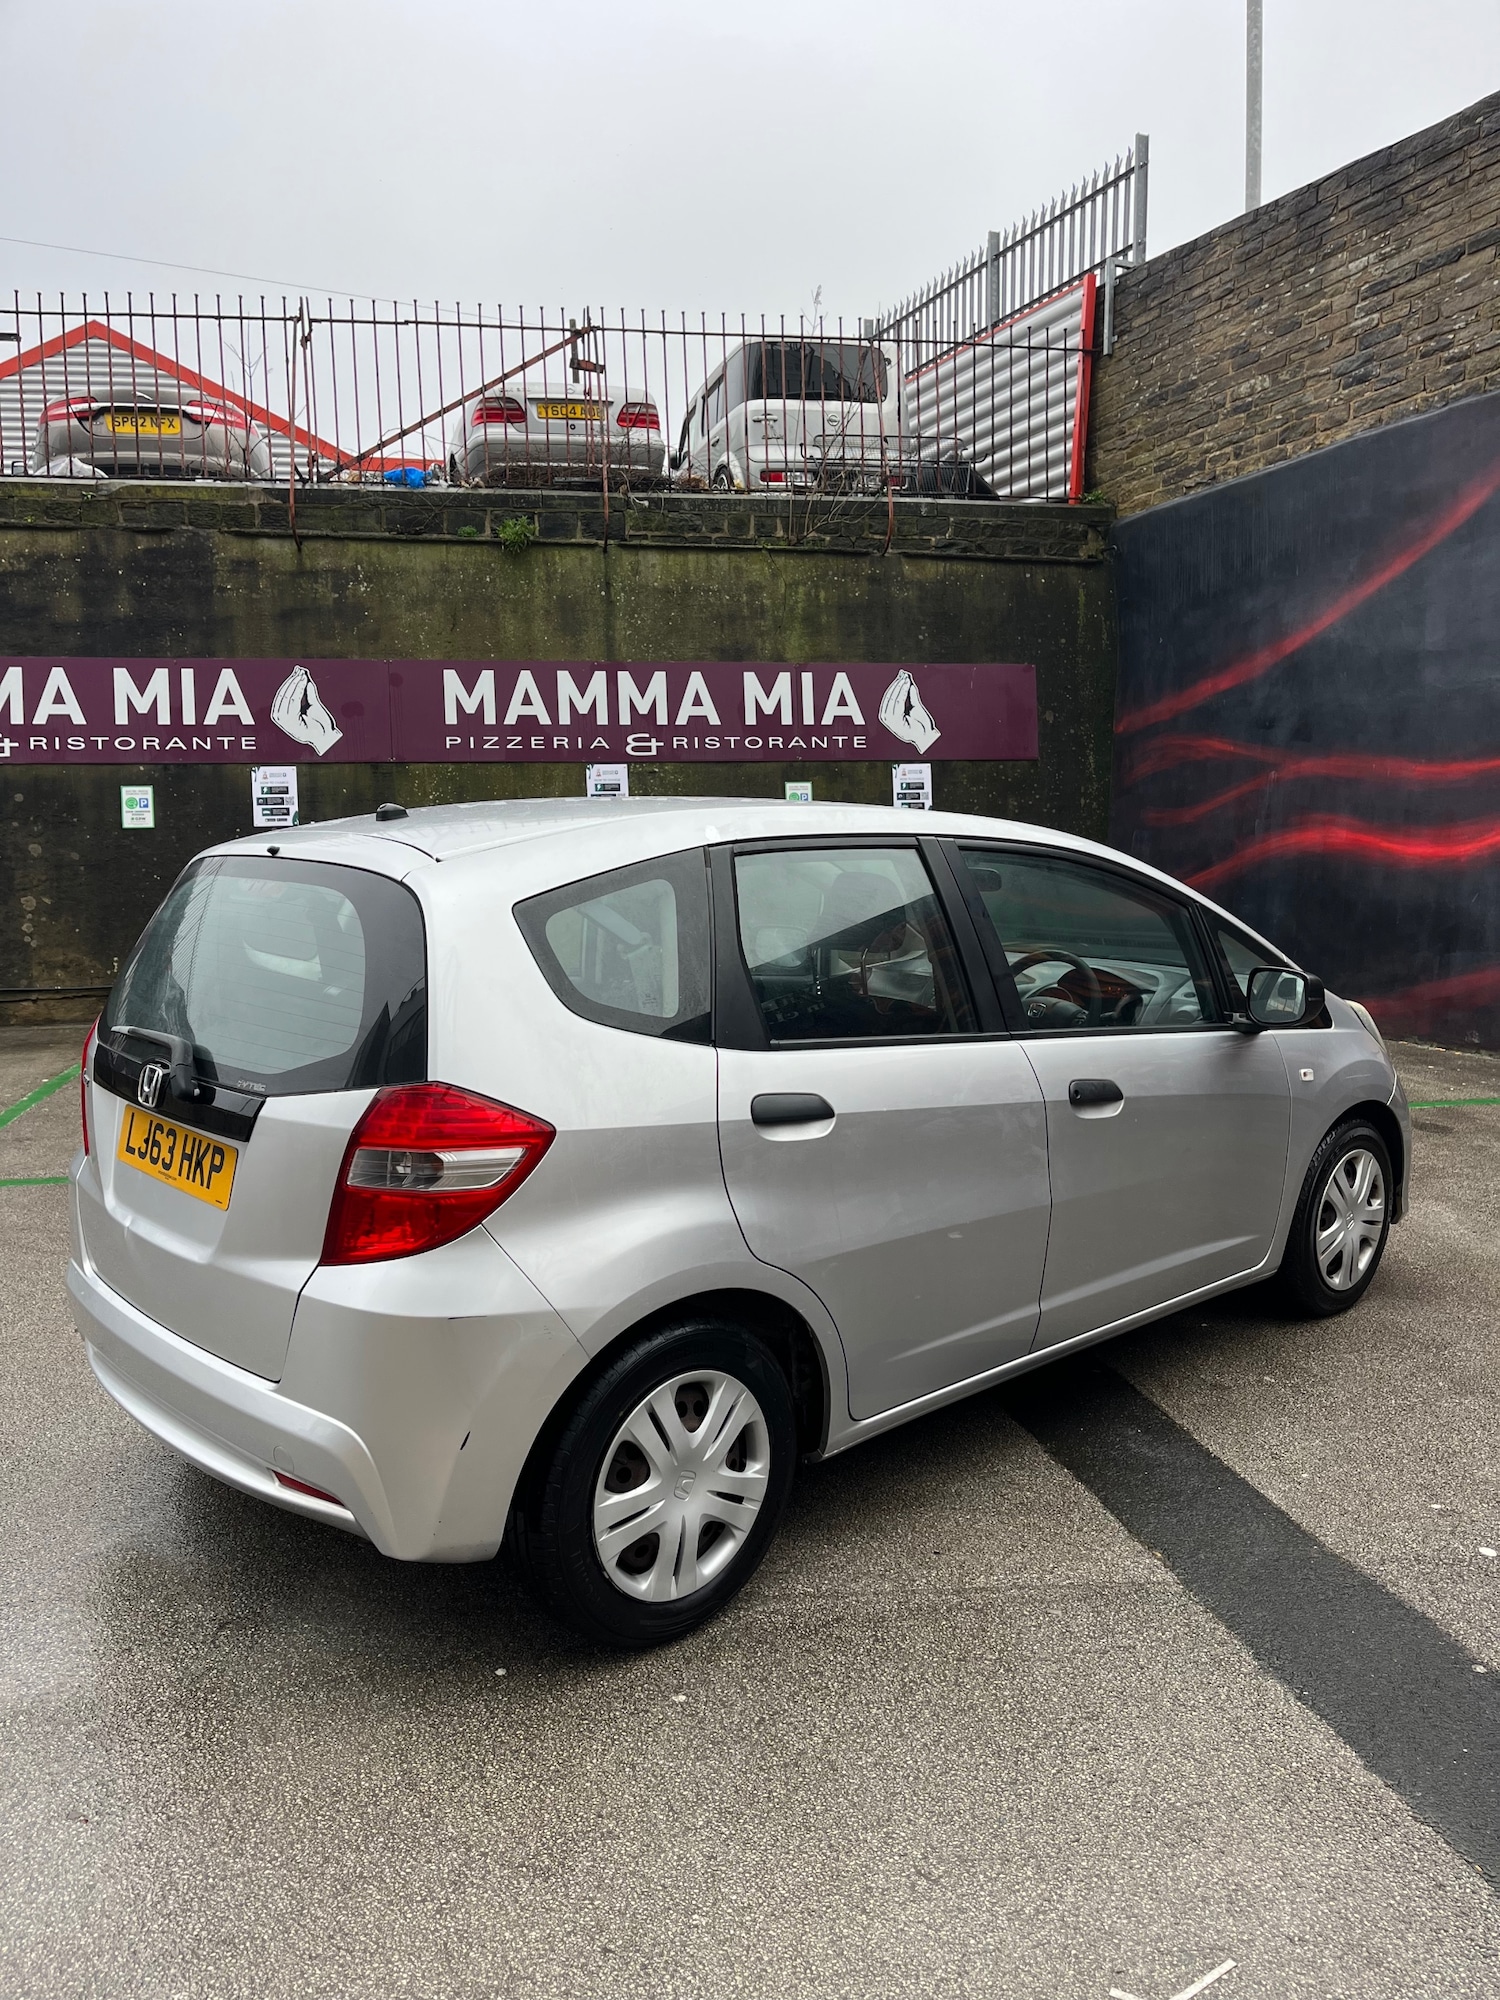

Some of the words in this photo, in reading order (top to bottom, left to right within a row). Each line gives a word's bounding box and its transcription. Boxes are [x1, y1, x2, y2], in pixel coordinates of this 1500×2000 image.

[113, 667, 256, 725] MIA
[443, 669, 722, 726] MAMMA
[743, 671, 866, 726] MIA
[29, 736, 257, 750] RISTORANTE
[445, 736, 610, 749] PIZZERIA
[625, 733, 665, 756] &
[672, 736, 867, 749] RISTORANTE
[125, 1112, 177, 1171] LJ63
[178, 1134, 226, 1189] HKP
